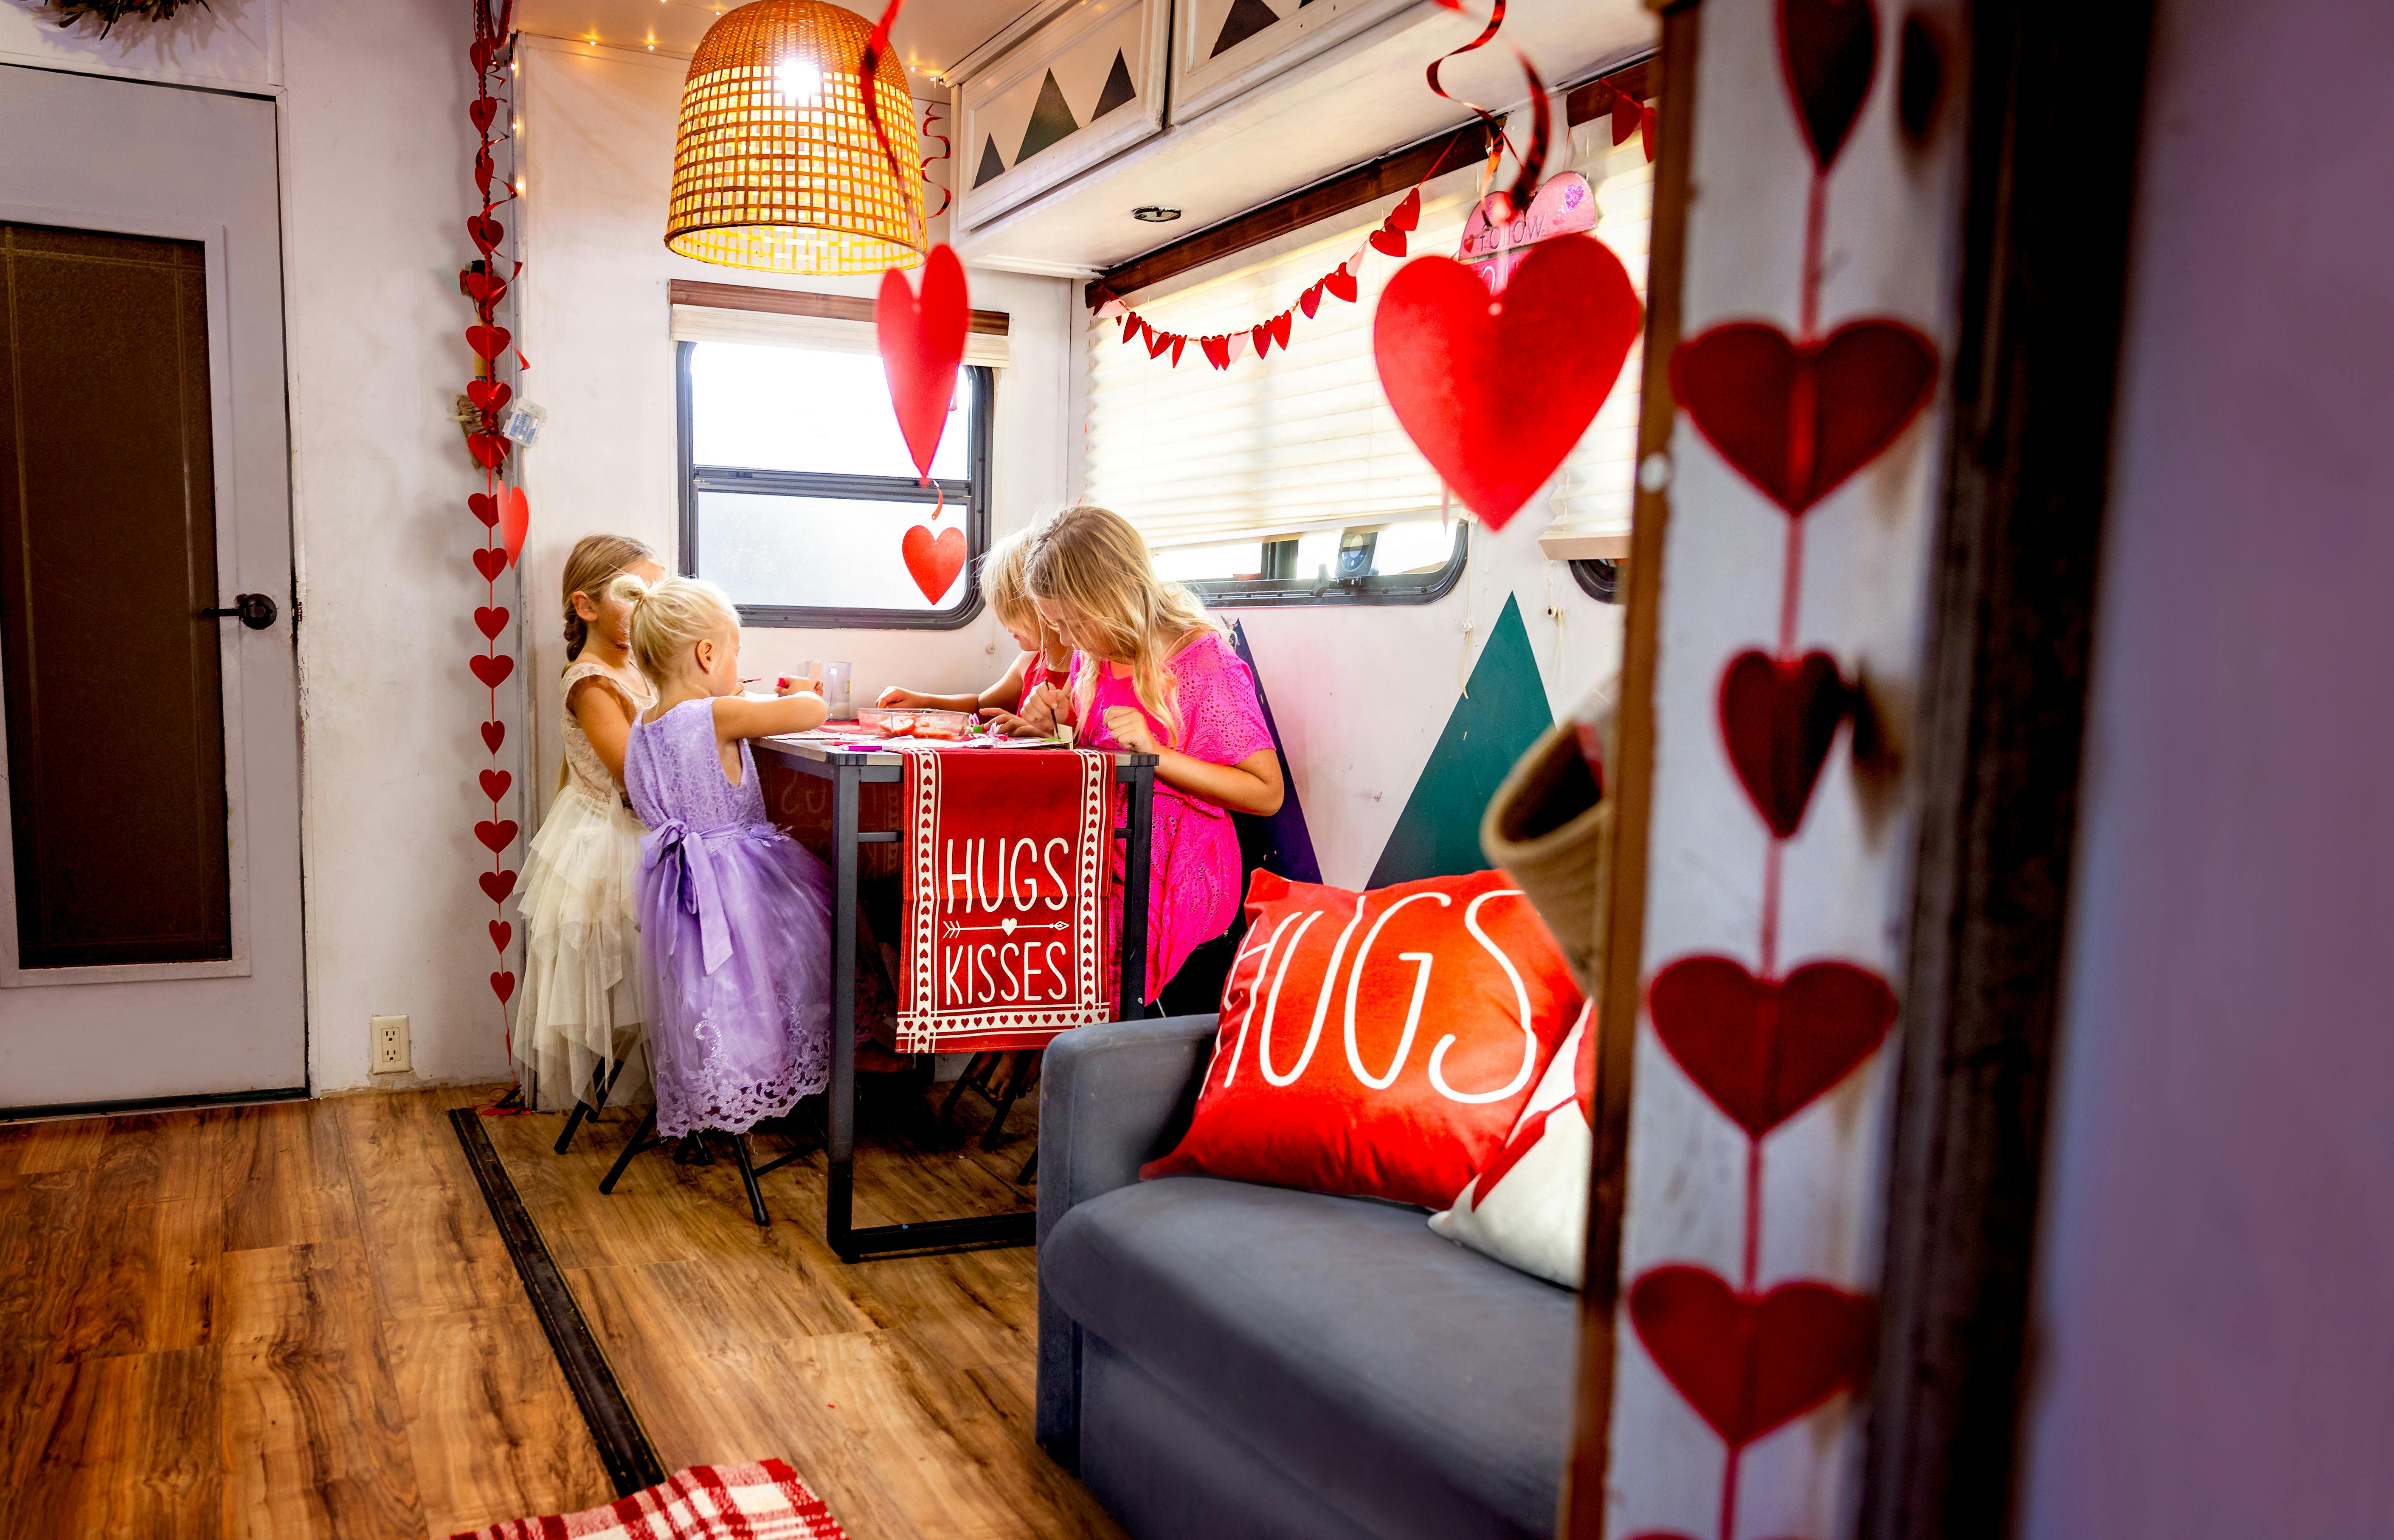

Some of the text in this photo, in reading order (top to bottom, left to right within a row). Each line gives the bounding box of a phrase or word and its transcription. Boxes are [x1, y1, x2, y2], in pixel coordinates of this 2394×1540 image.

[946, 837, 1069, 914] HUGS
[945, 941, 1067, 1005] KISSES
[1198, 889, 1538, 1104] HUGS
